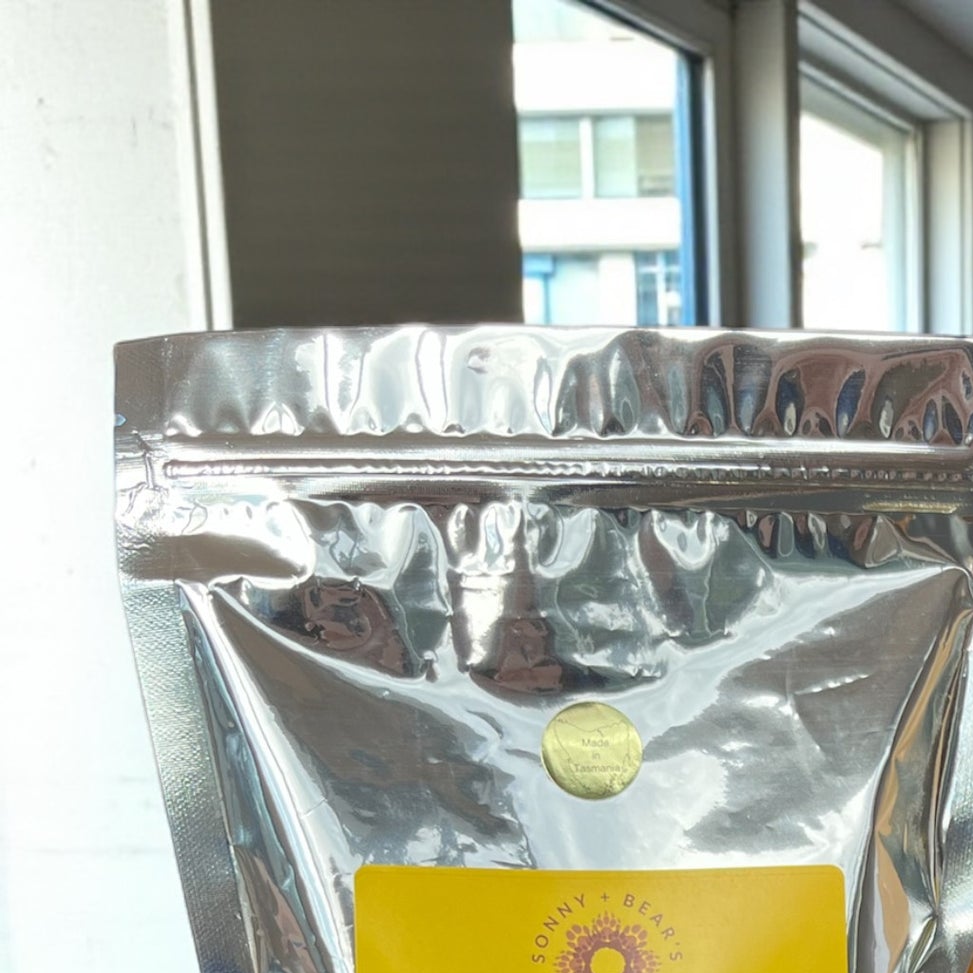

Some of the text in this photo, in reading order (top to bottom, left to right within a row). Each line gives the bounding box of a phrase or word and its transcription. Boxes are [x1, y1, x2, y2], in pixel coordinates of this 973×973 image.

[582, 738, 609, 747] Made
[592, 752, 601, 760] in
[574, 763, 621, 773] Tasmania
[532, 893, 586, 963] SONNY
[623, 893, 683, 961] BEAR'S
